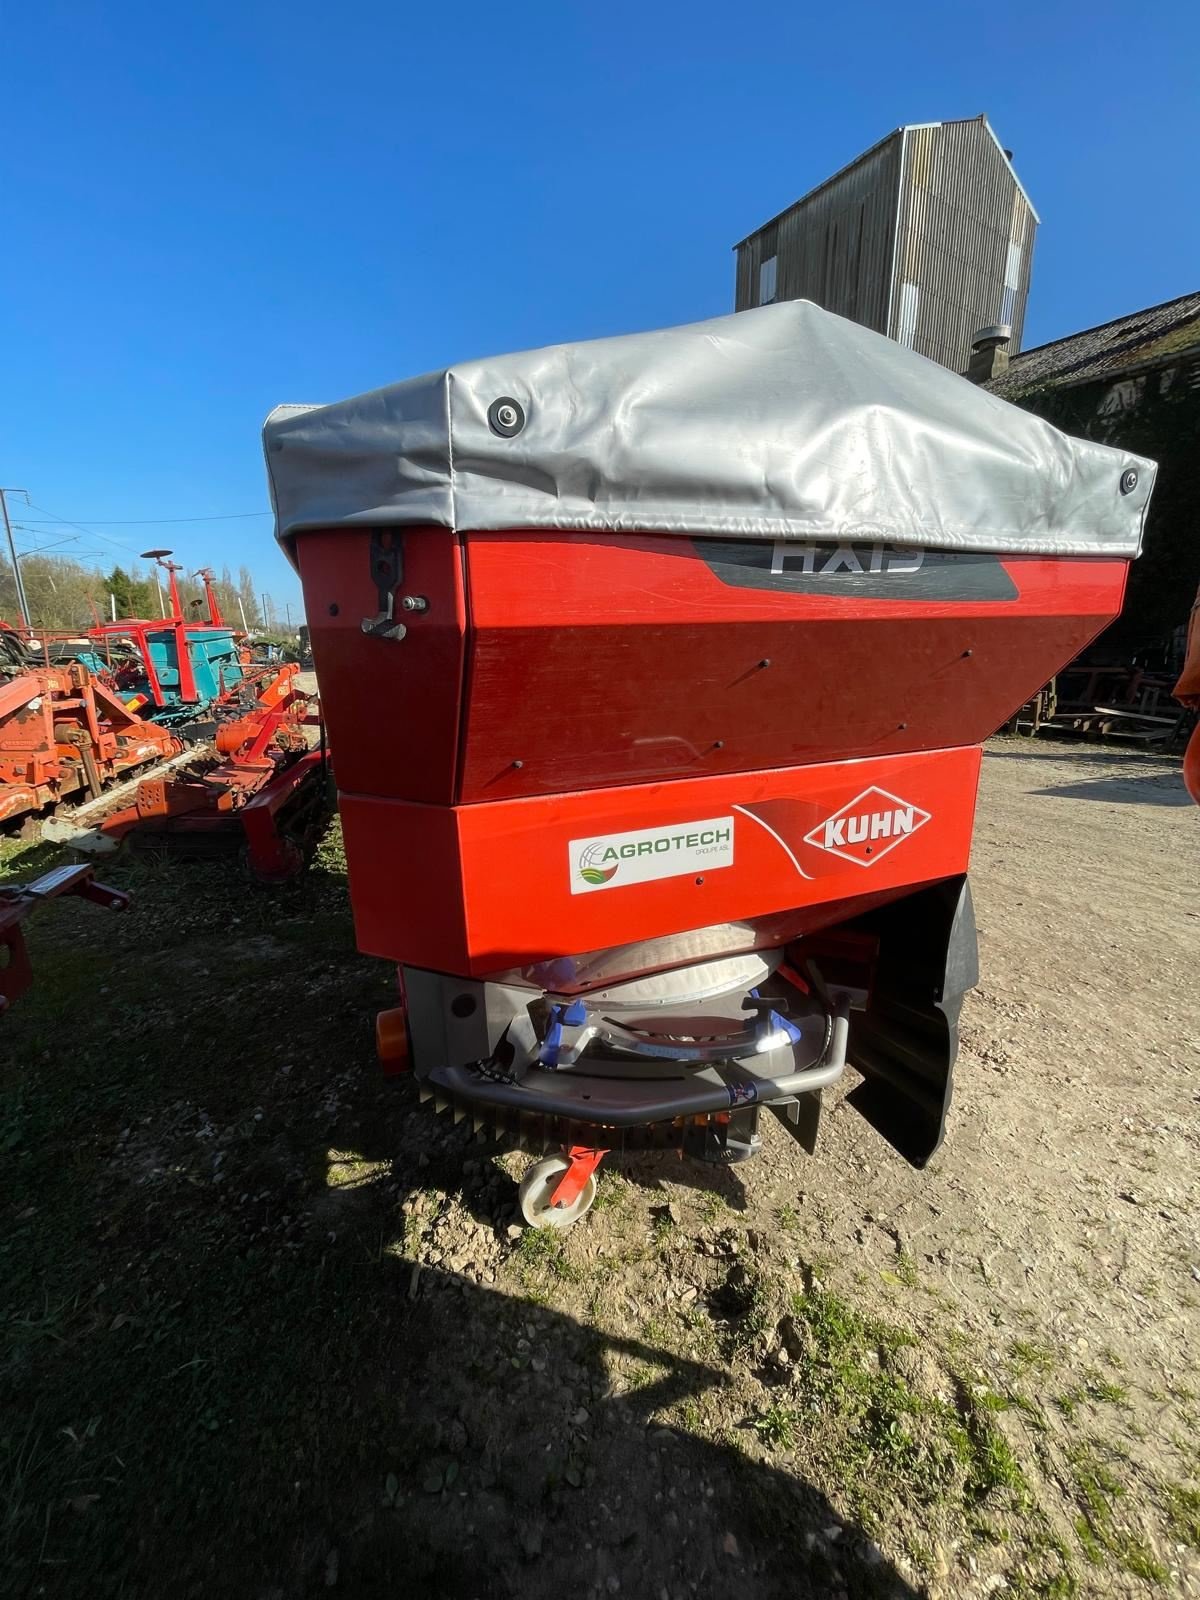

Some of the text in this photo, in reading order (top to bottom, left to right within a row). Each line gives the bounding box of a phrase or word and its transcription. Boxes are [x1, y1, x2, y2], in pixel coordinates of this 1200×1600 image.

[823, 807, 914, 848] KUHN
[601, 828, 730, 862] AGROTECH
[695, 846, 718, 856] GROUPE
